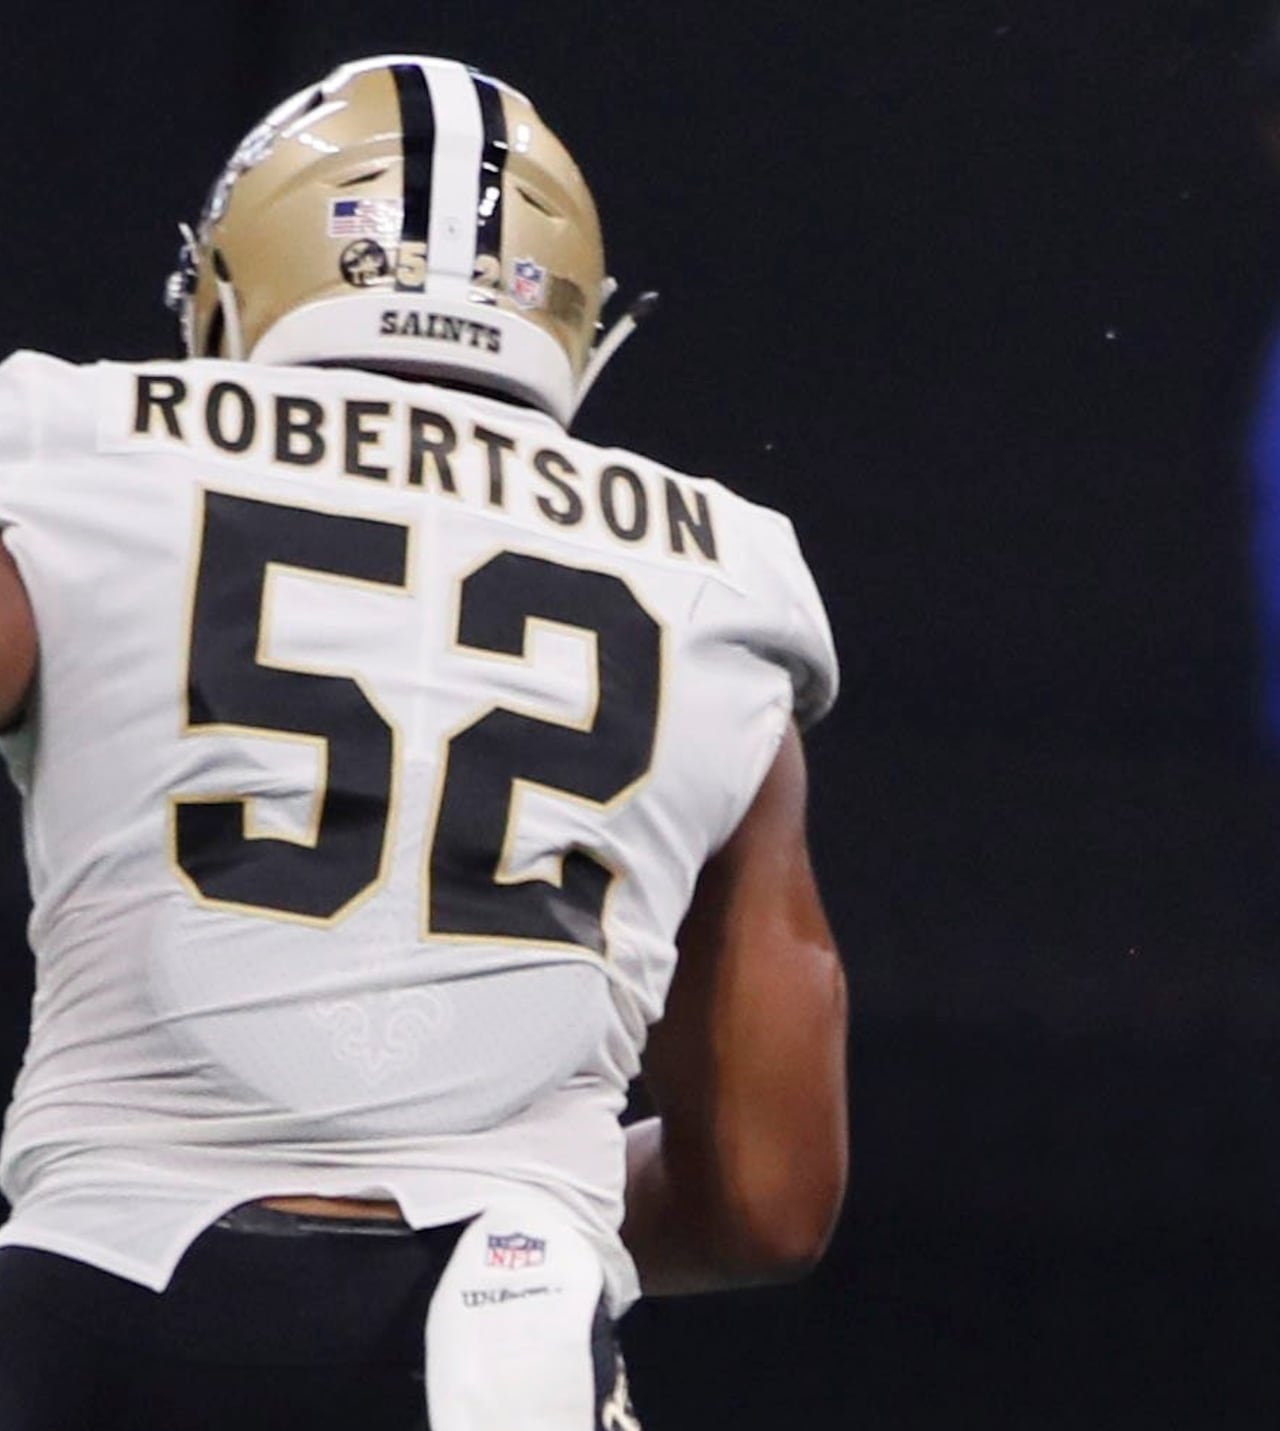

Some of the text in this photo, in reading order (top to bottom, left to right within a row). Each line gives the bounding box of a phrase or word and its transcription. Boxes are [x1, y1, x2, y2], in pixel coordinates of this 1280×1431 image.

[379, 309, 502, 354] SAINTS
[128, 371, 724, 565] ROBERTSON
[166, 482, 671, 965] 52
